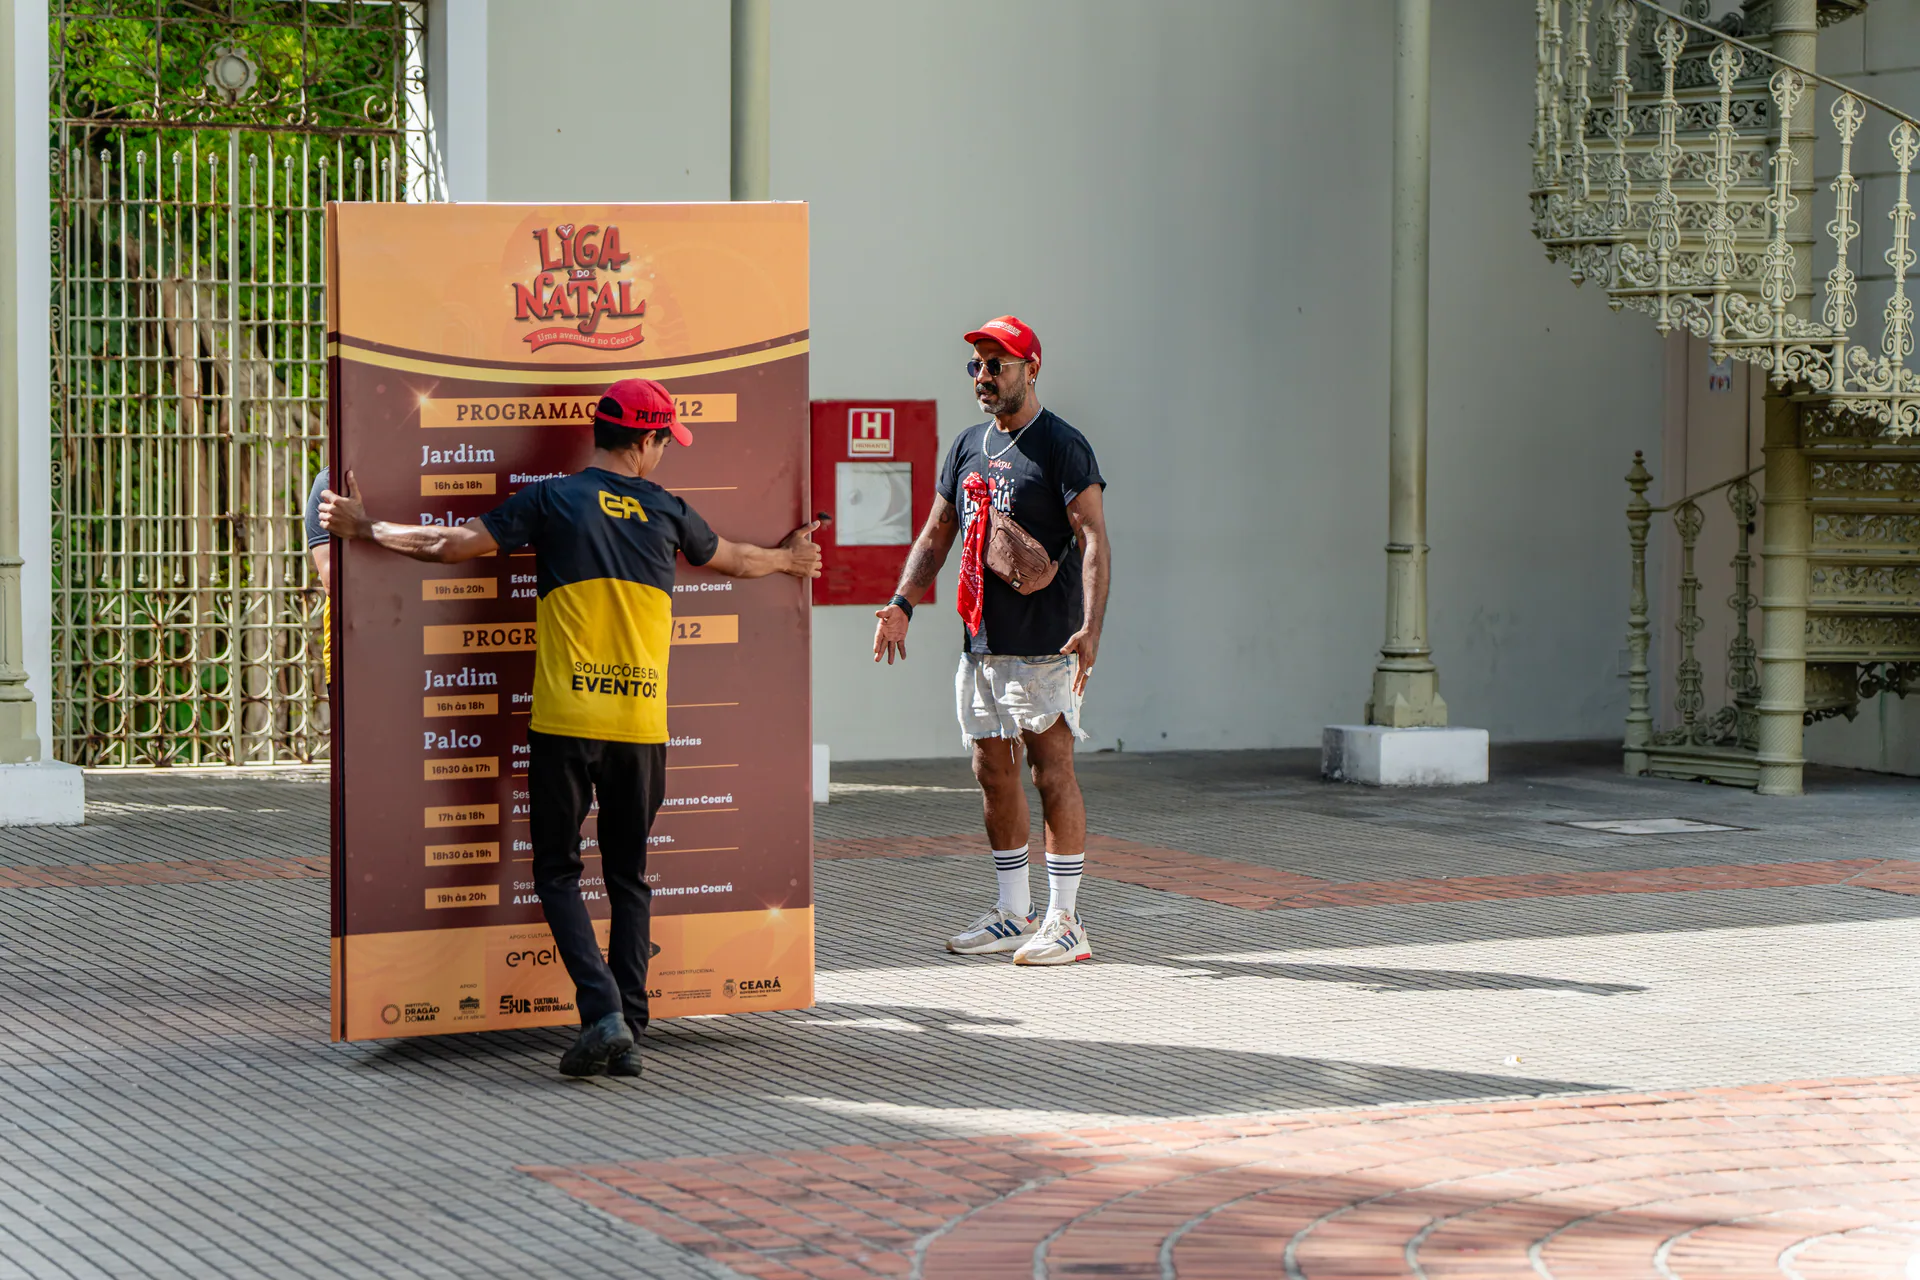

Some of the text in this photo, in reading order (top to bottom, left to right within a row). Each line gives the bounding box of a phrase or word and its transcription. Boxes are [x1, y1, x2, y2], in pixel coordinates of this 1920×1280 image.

[576, 270, 590, 278] DO
[512, 272, 646, 335] NATAL
[537, 332, 635, 345] Uma aventura no Ceará
[456, 397, 703, 423] PROGRAMAÇ /12
[636, 410, 673, 424] PUMA
[861, 412, 882, 439] H
[420, 443, 495, 467] Jardim
[434, 479, 482, 490] 16h às 18h
[420, 510, 476, 528] Palc
[511, 574, 538, 584] Estre
[435, 584, 484, 594] 19h às 20h
[511, 589, 520, 598] A
[521, 588, 538, 598] LIG
[686, 584, 699, 592] no
[700, 581, 733, 592] Ceará
[463, 620, 702, 648] PROGR /12
[574, 661, 647, 679] SOLUÇÕES
[424, 667, 498, 691] Jardim
[571, 674, 657, 698] EVENTOS
[437, 701, 485, 711] 16h às 18h
[424, 729, 482, 750] Palco
[512, 736, 702, 754] Pat stórias
[432, 763, 491, 774] 16h30 às 17h
[512, 790, 530, 799] Ses
[662, 793, 733, 806] tura no Ceará
[512, 804, 530, 814] A LI
[438, 811, 485, 822] 17h às 18h
[646, 835, 675, 846] nças.
[432, 849, 492, 860] 18h30 às 19h
[686, 885, 700, 894] no
[701, 882, 733, 893] Ceará
[437, 892, 487, 903] 19h às 20h
[513, 895, 521, 905] A
[522, 895, 542, 904] LIG
[581, 891, 600, 900] TAL
[506, 944, 557, 968] enel
[740, 976, 781, 990] CEARÁ
[534, 997, 559, 1005] CULTURAL
[405, 1006, 440, 1015] DRAGÃO
